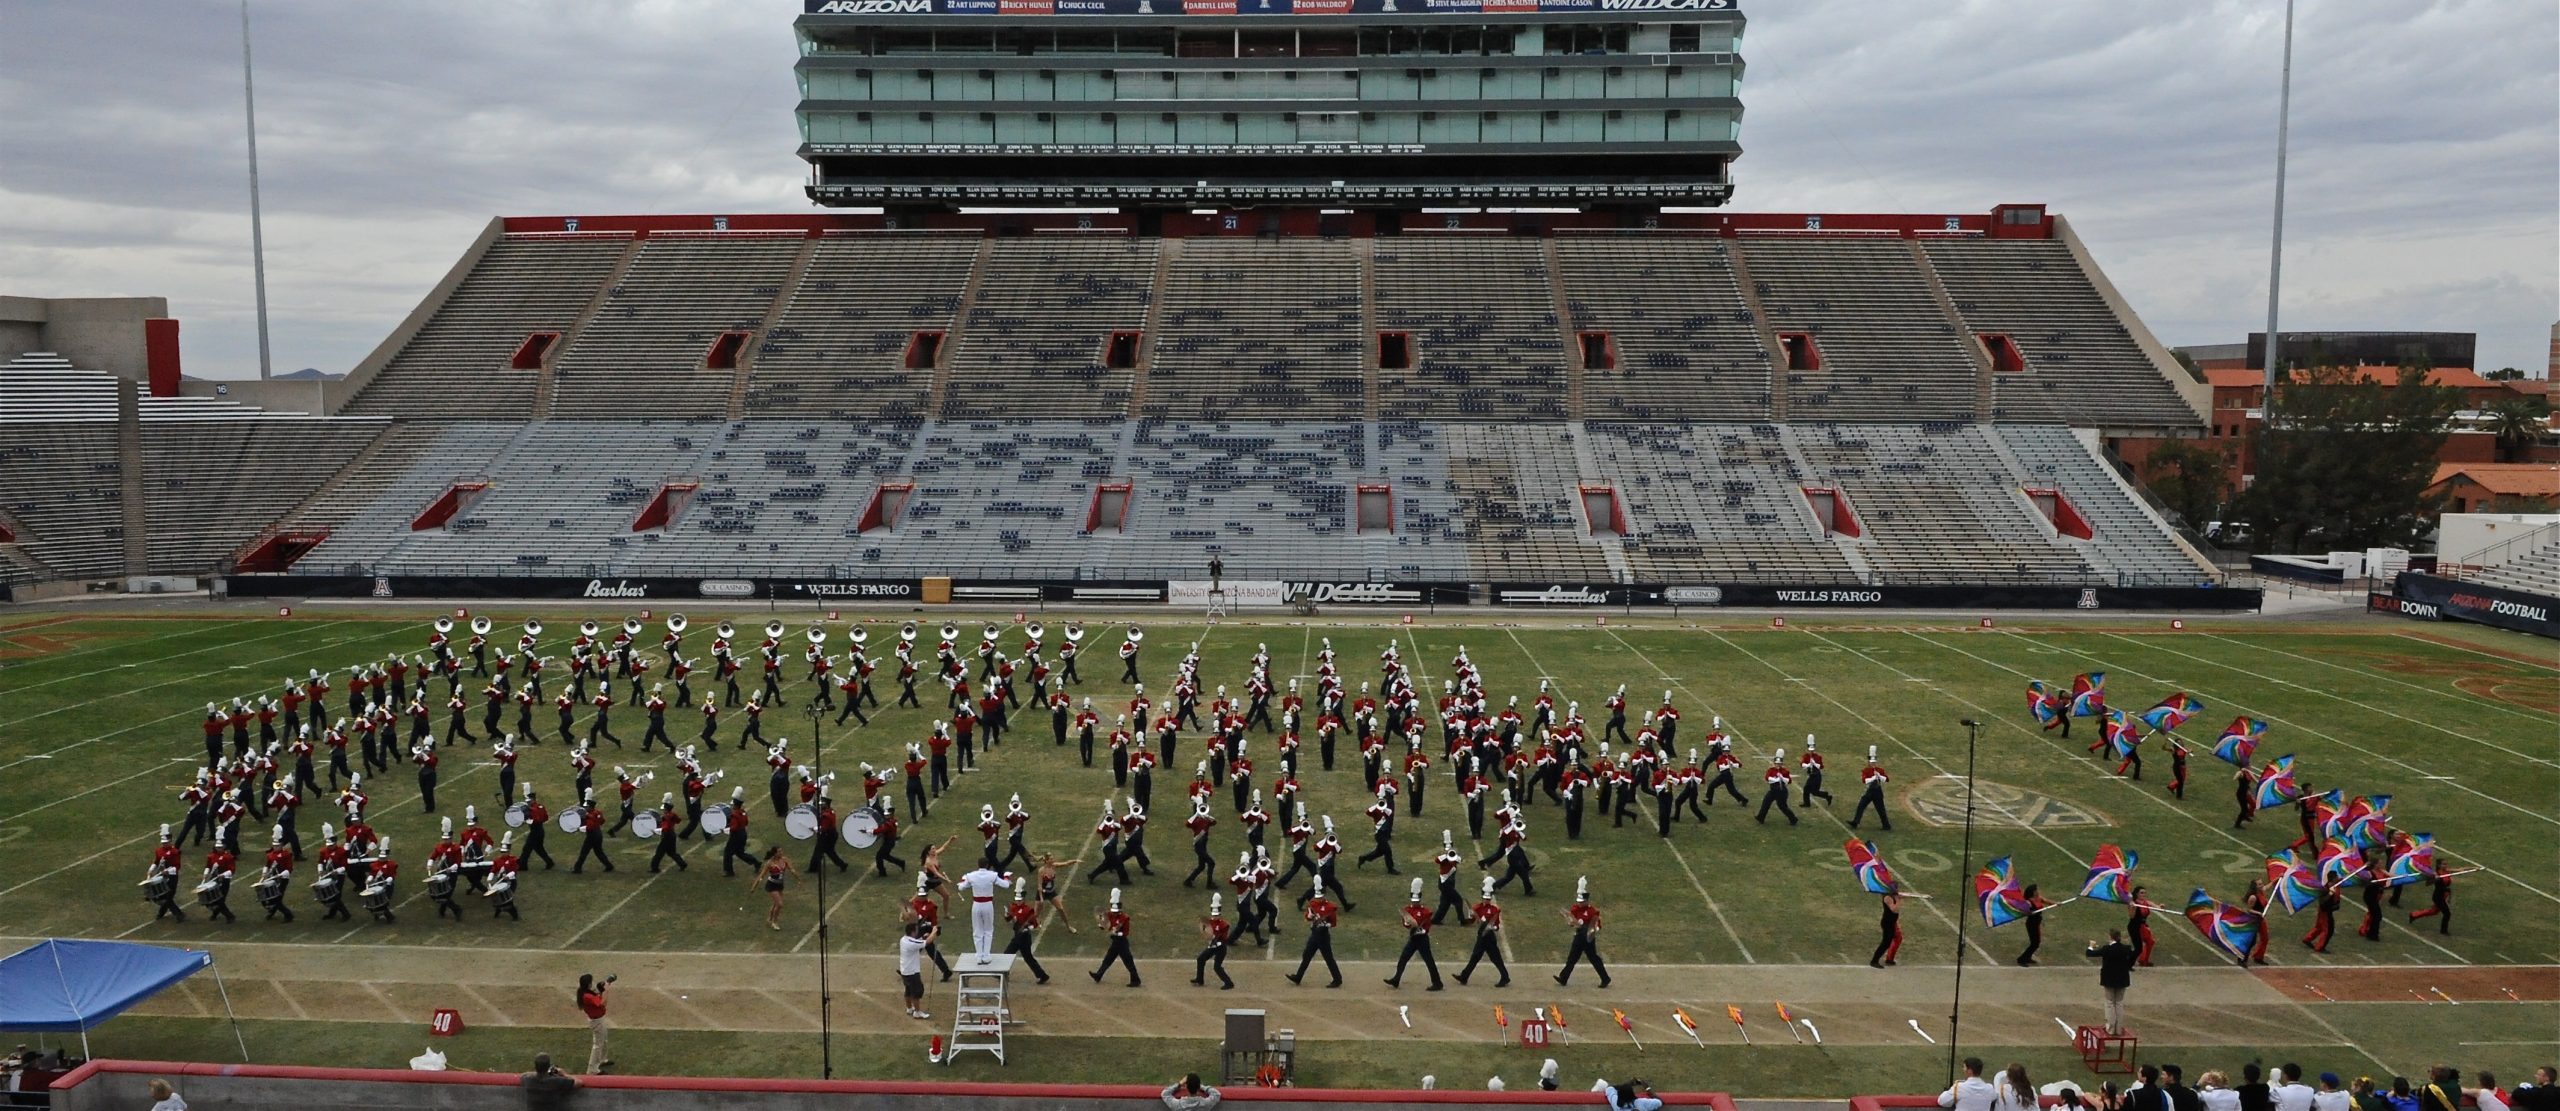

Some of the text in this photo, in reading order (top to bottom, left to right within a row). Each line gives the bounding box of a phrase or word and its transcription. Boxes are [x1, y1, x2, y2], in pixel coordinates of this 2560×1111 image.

[817, 1, 932, 13] ARIZONA
[947, 1, 996, 9] 22 ART LUPPINO
[1009, 1, 1028, 9] RICKY
[1029, 1, 1053, 9] HUNLEY
[1063, 1, 1086, 9] CHUCK
[1087, 1, 1105, 9] CECIL
[1183, 1, 1237, 9] 4 DARRYLL LEWIS
[1302, 0, 1315, 8] ROB
[1316, 0, 1347, 8] WALDROP
[1602, 0, 1727, 9] WILDCATS
[567, 222, 577, 232] 17
[716, 221, 727, 231] 18
[1078, 219, 1091, 228] 20
[1225, 219, 1237, 229] 21
[1447, 219, 1459, 229] 22
[1645, 219, 1658, 229] 23
[1807, 220, 1820, 230] 24
[1946, 221, 1959, 231] 25
[217, 384, 227, 394] 16
[583, 579, 647, 597] Bashas'
[720, 583, 751, 592] CASINOS
[807, 584, 910, 595] WELLS FARGO
[1170, 587, 1206, 597] UNIVERSITY
[1246, 587, 1265, 598] BAND
[1266, 587, 1280, 598] DAY
[1684, 591, 1716, 600] CASINOS
[1776, 590, 1882, 602] WELLS FARGO
[2400, 600, 2437, 618] DOWN
[2489, 599, 2548, 621] FOOTBALL
[433, 1012, 452, 1032] 40
[1525, 1023, 1544, 1043] 40
